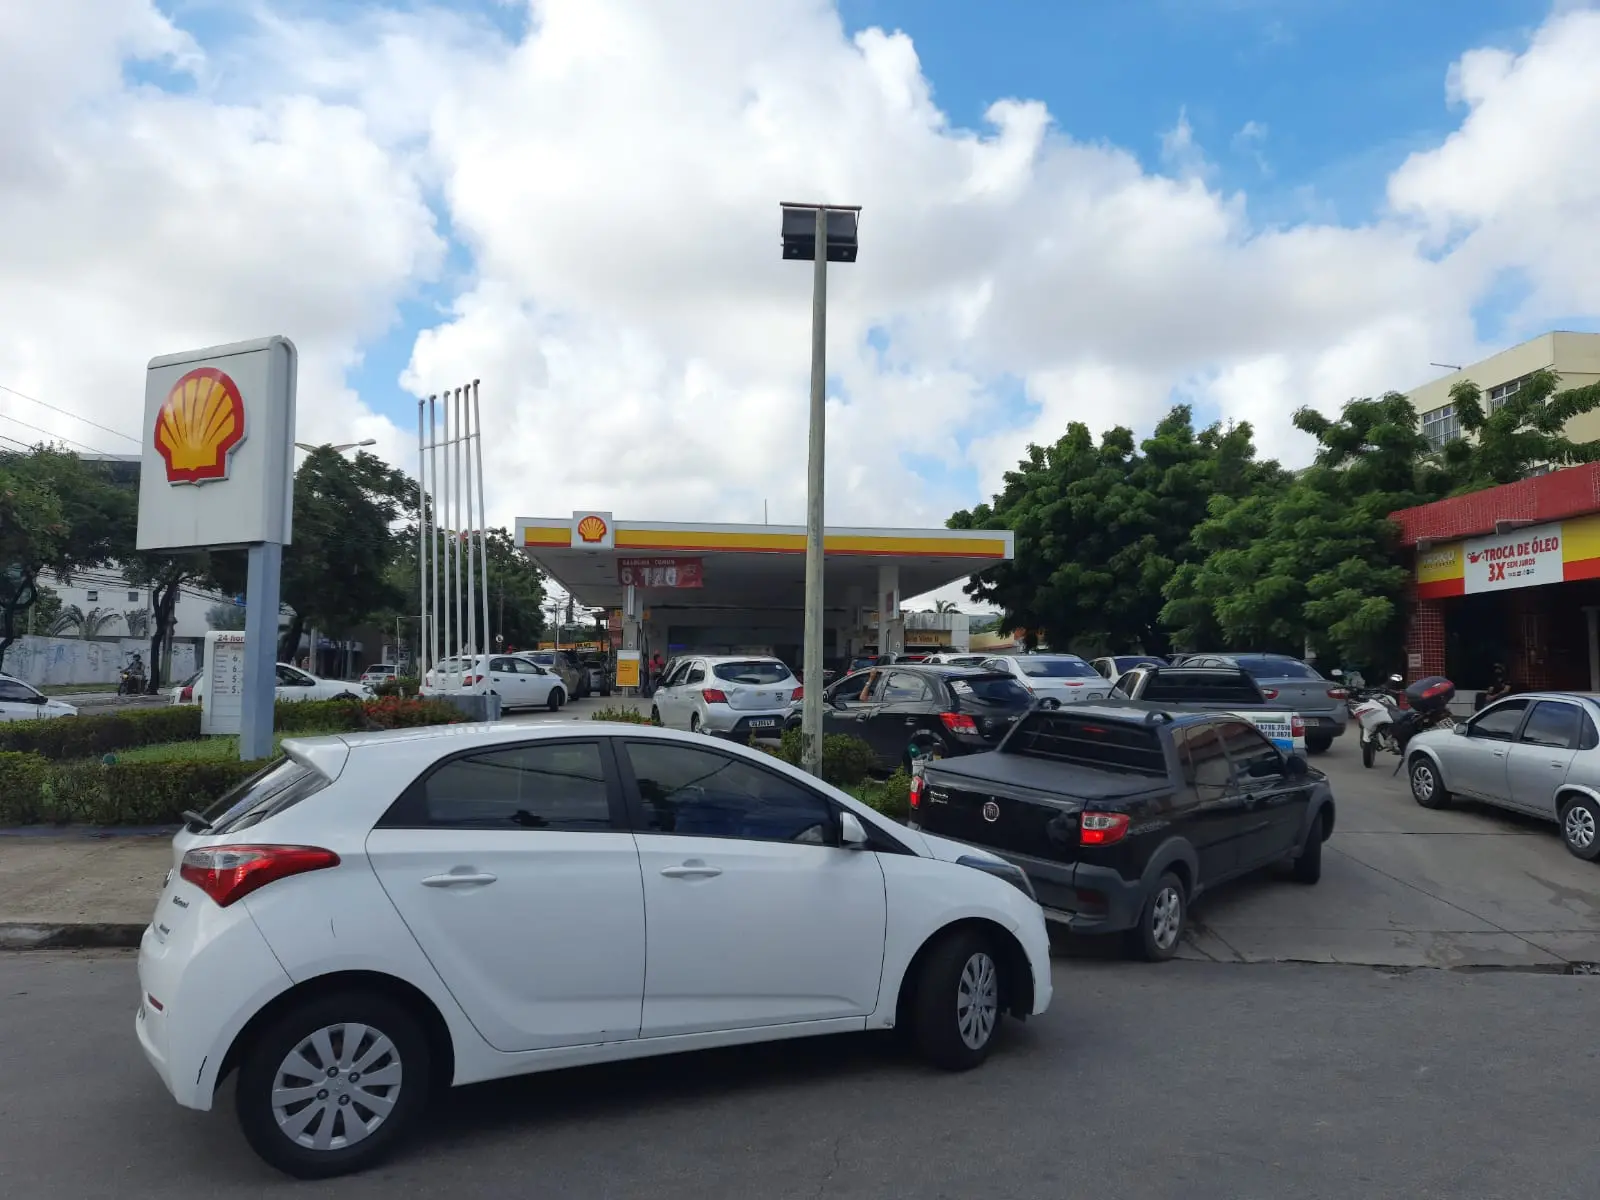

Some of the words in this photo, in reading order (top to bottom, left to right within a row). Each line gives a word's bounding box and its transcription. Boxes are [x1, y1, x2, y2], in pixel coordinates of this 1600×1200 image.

[1484, 544, 1515, 562] TROCA
[1517, 542, 1530, 557] DE
[1532, 535, 1559, 553] ÓLEO
[1488, 560, 1506, 582] 3X
[1506, 560, 1518, 569] SEM
[1518, 557, 1536, 568] JUROS
[217, 634, 229, 642] 24
